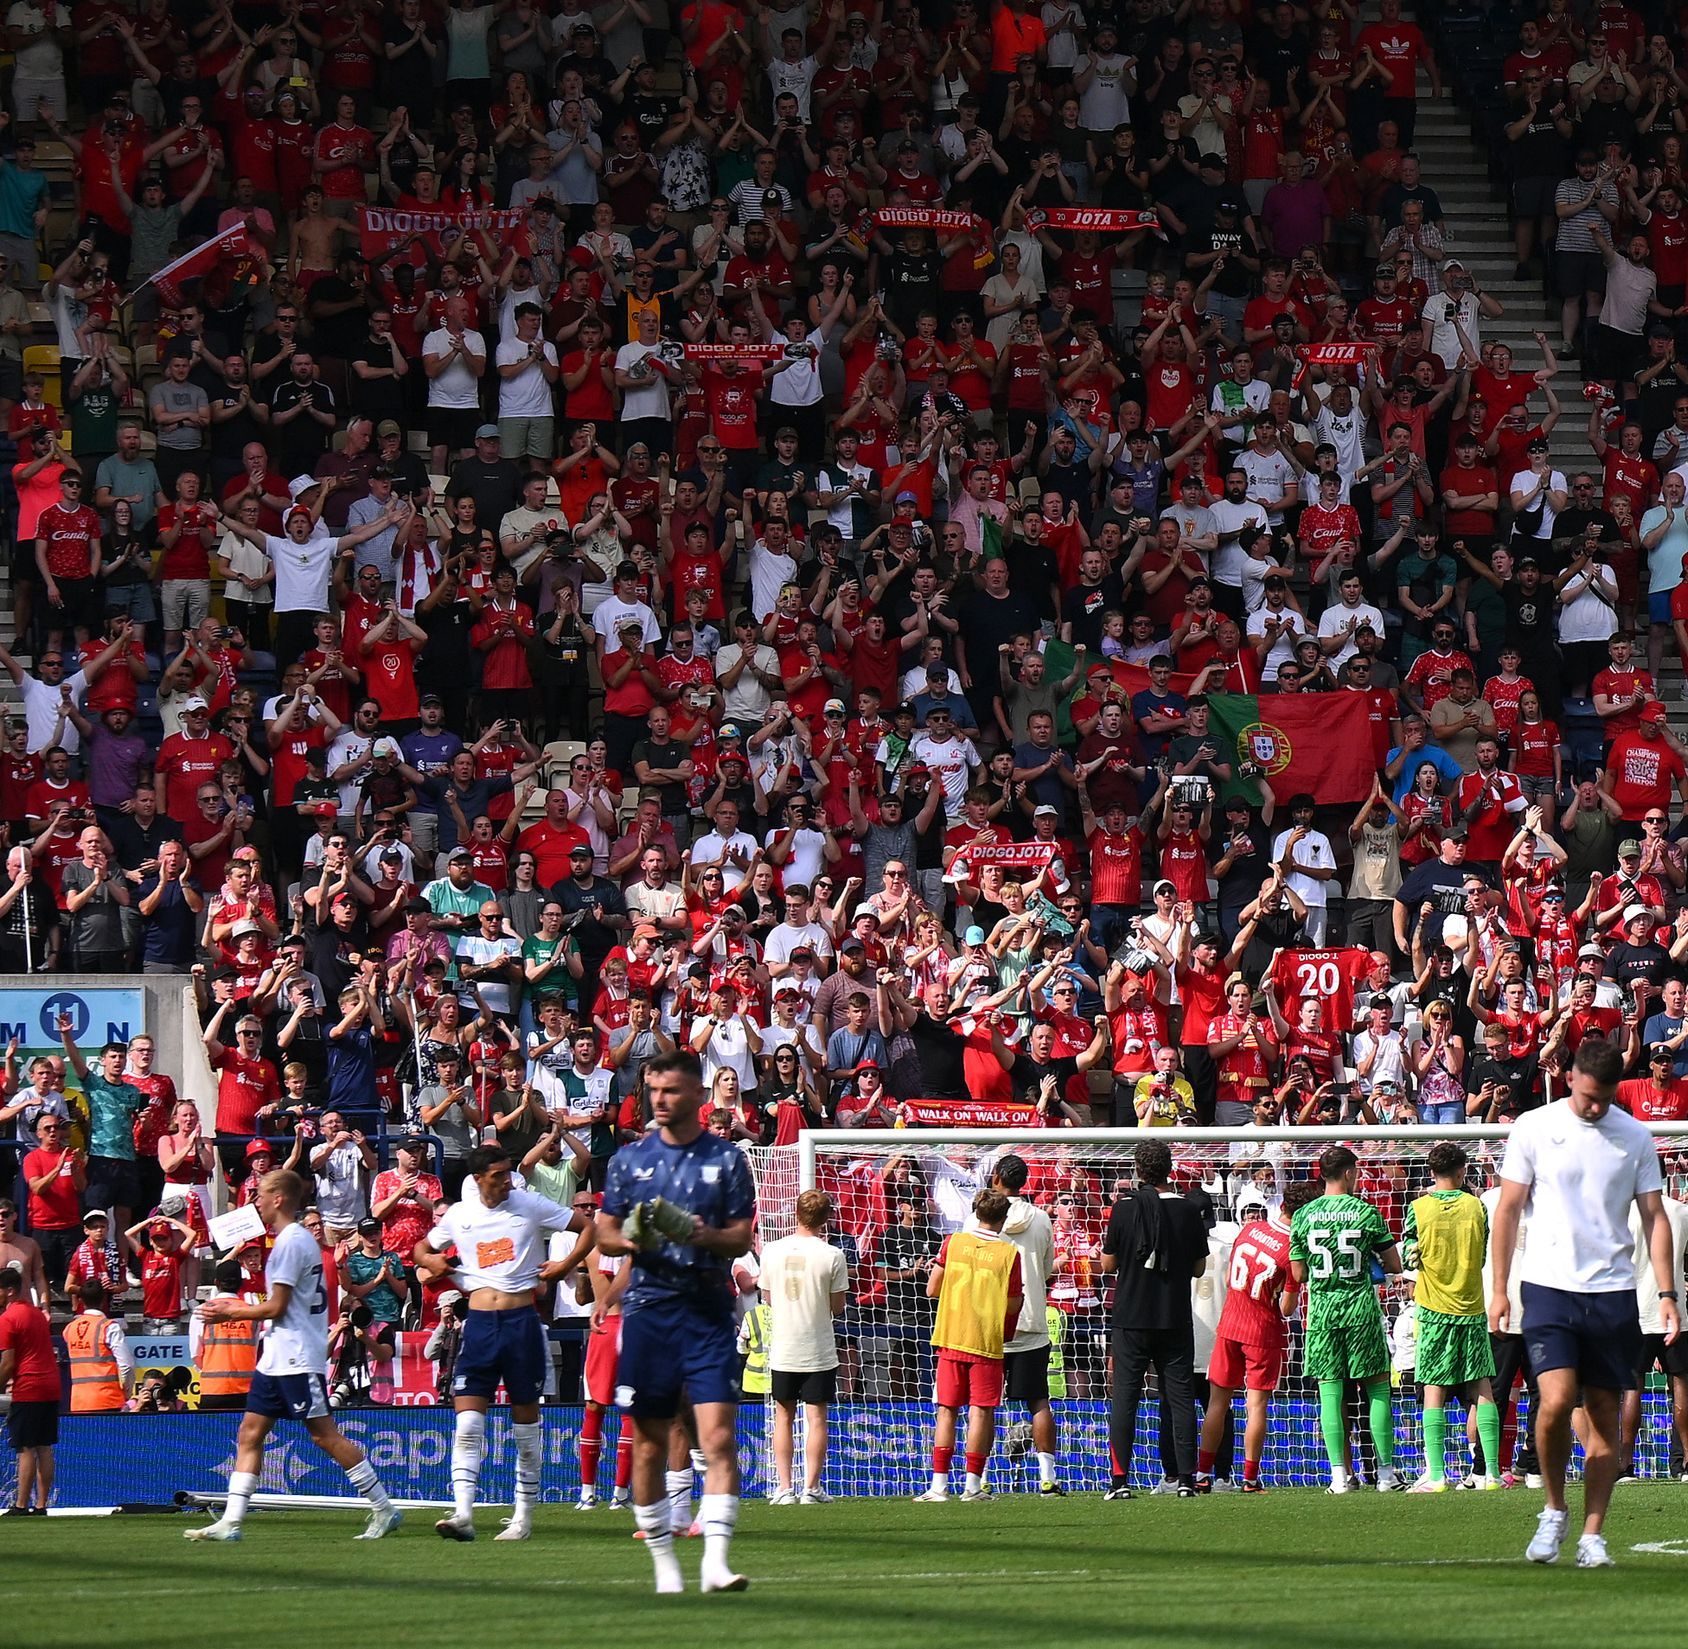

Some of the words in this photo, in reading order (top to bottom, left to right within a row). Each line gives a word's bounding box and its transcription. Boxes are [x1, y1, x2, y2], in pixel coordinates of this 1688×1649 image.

[880, 210, 930, 223] DIOGO
[935, 213, 972, 227] JOTA
[1056, 213, 1066, 221] 20
[1073, 212, 1112, 225] JOTA
[1119, 214, 1128, 222] 20
[1211, 232, 1242, 242] AWAY
[687, 344, 736, 352] DIOGO
[739, 344, 779, 352] JOTA
[1317, 347, 1356, 359] JOTA
[51, 530, 90, 542] Candy
[1313, 526, 1347, 539] Cand
[386, 657, 397, 667] 20
[972, 845, 1016, 859] DIOGO
[1016, 845, 1052, 858] JOTA
[1298, 953, 1330, 962] DIOGO
[1297, 965, 1340, 996] 20
[53, 1000, 74, 1031] 11
[0, 1022, 27, 1043] M
[107, 1022, 129, 1043] N
[541, 1052, 570, 1066] Carlsberg
[572, 1096, 603, 1109] Carlsberg
[917, 1107, 951, 1121] WALK
[954, 1109, 972, 1121] ON
[975, 1110, 1010, 1123] WALK
[1012, 1112, 1030, 1124] ON
[1308, 1211, 1361, 1223] WOODMAN
[1248, 1227, 1284, 1251] KOUMAS
[1306, 1229, 1362, 1280] 55
[1229, 1241, 1278, 1300] 67
[220, 1321, 247, 1331] H&A
[71, 1340, 91, 1351] H&A
[134, 1345, 184, 1359] GATE
